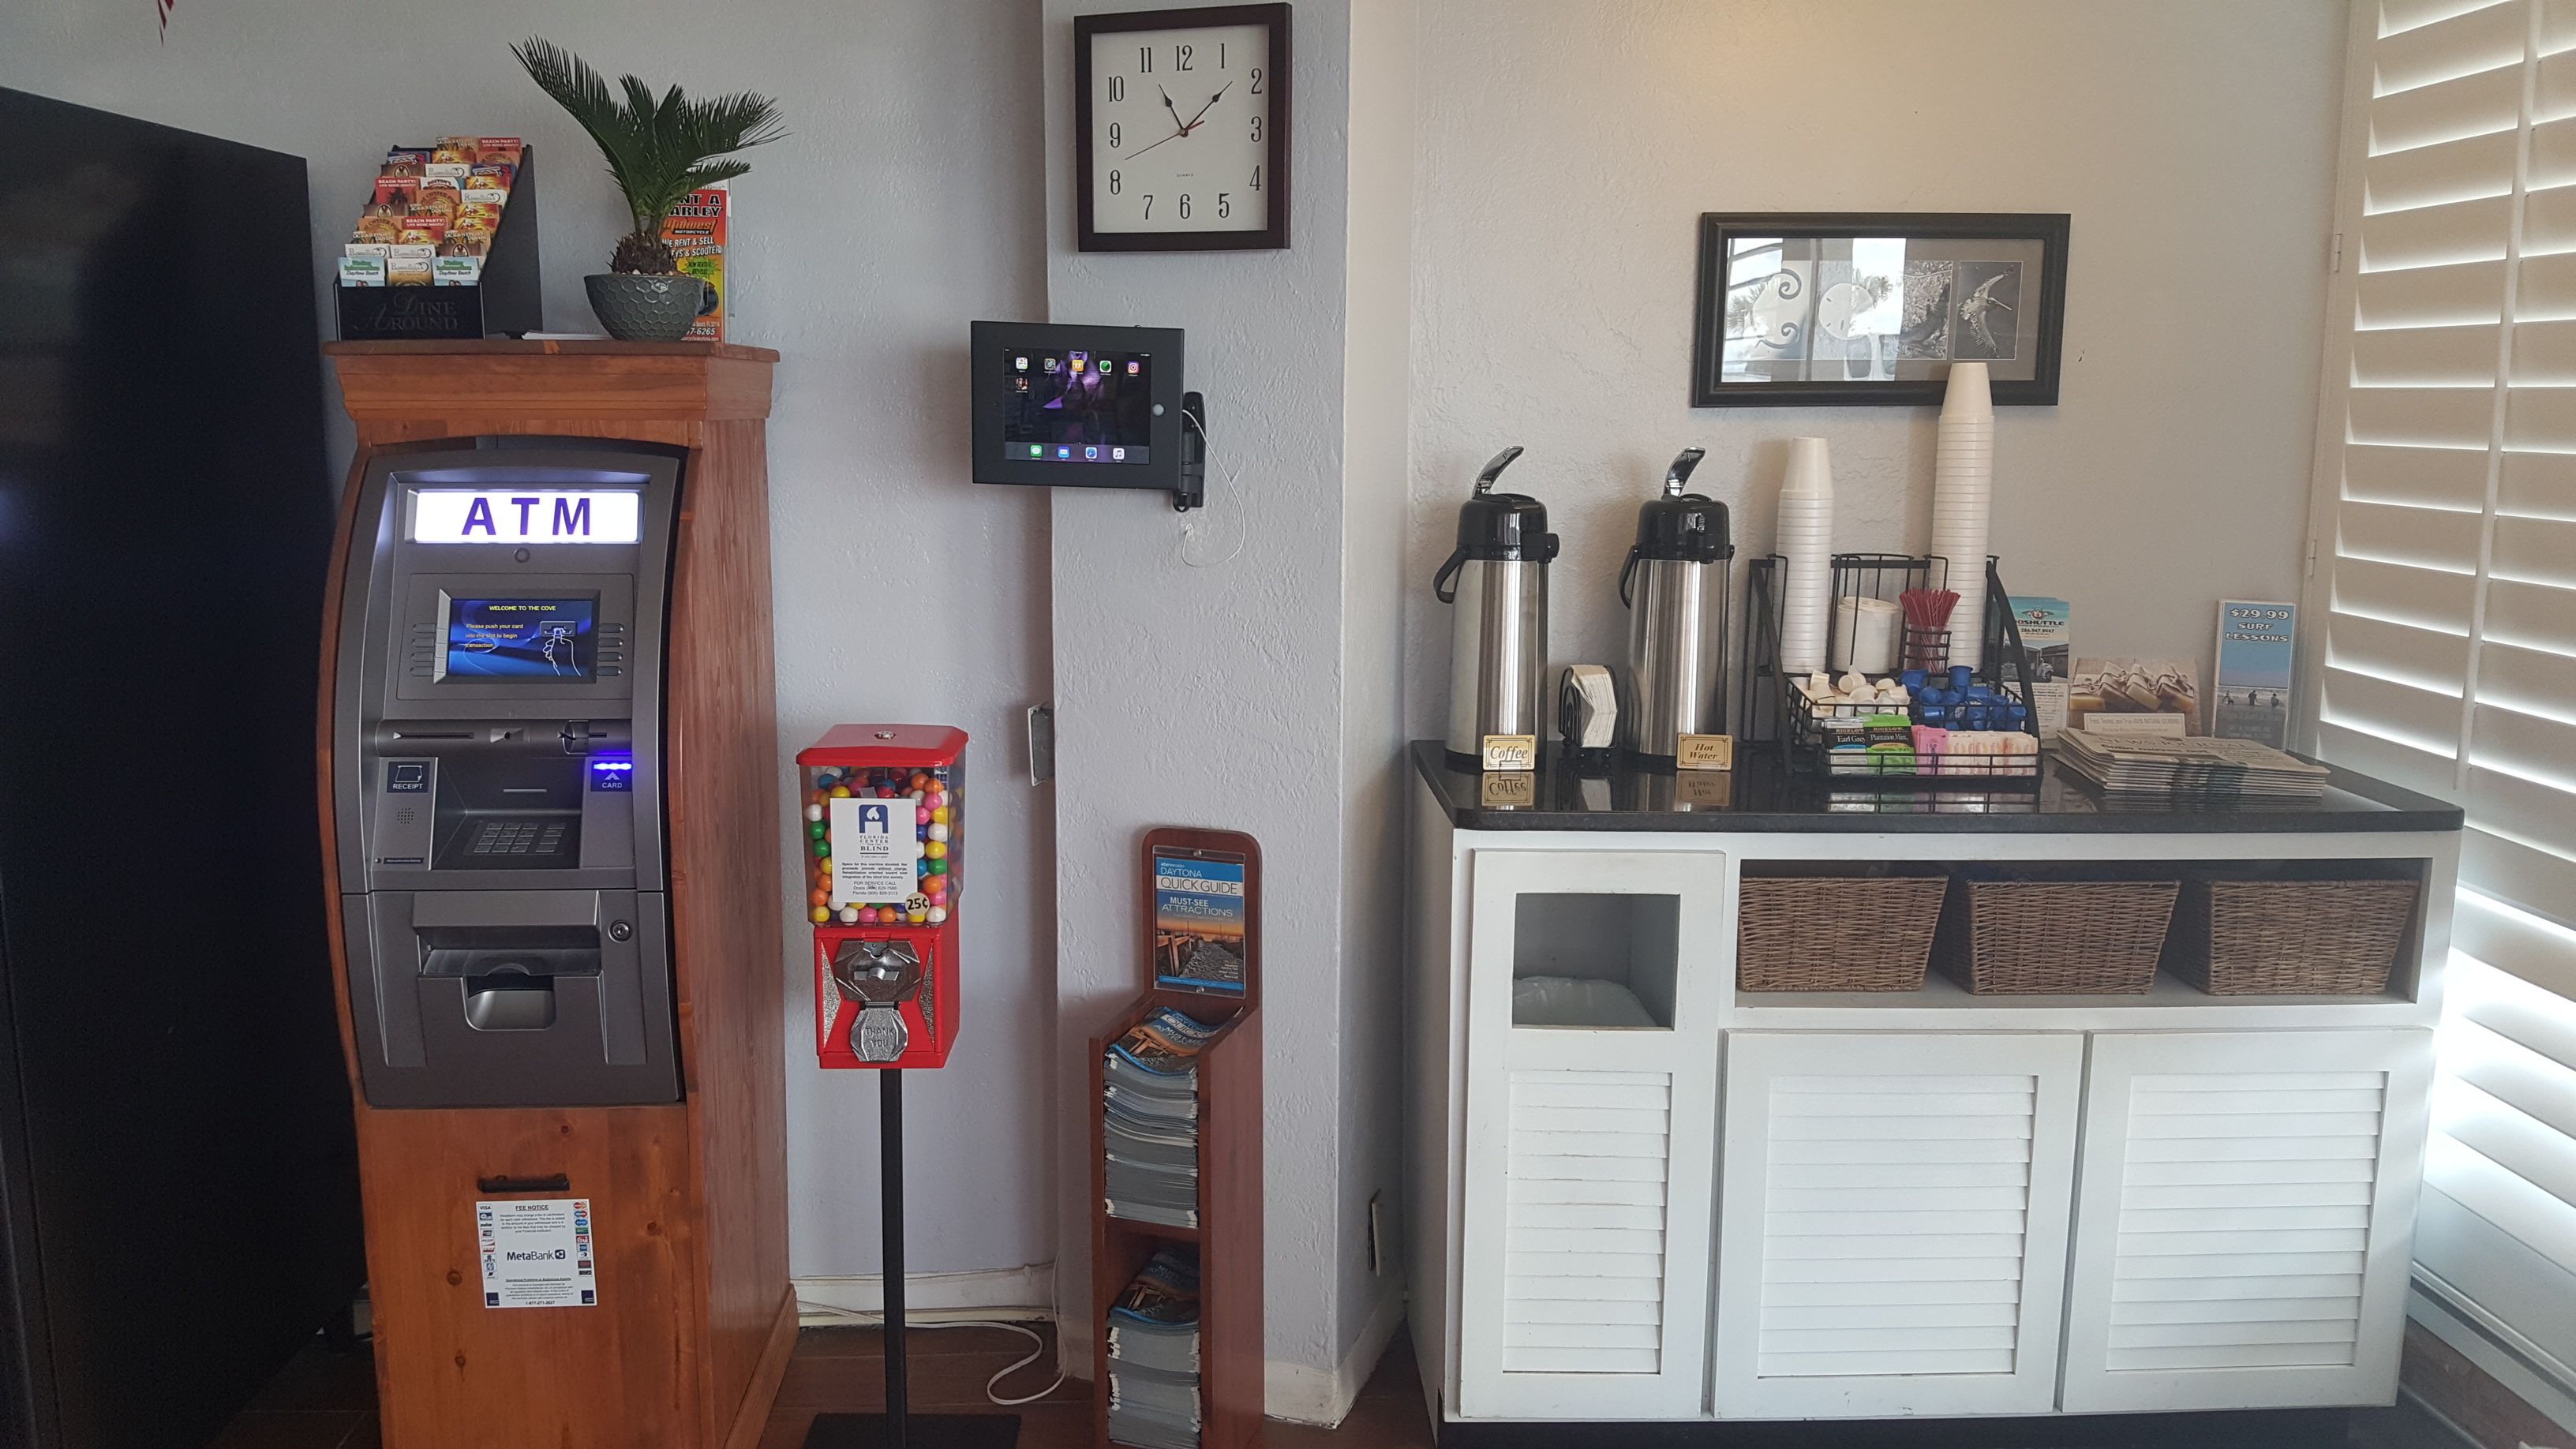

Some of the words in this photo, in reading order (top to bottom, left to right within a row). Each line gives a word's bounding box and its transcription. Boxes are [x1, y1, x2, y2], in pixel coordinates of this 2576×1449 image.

[1140, 47, 1151, 73] 11
[1176, 45, 1193, 71] 12
[1220, 43, 1225, 69] 1
[1108, 76, 1124, 102] 10
[1251, 68, 1262, 94] 2
[1110, 122, 1121, 148] 9
[1251, 116, 1261, 142] 3
[1110, 170, 1121, 195] 8
[1249, 165, 1261, 190] 4
[709, 194, 721, 205] A
[1143, 195, 1153, 220] 7
[1180, 194, 1190, 219] 6
[1219, 193, 1230, 218] 5
[668, 206, 721, 217] ARLEY
[675, 238, 691, 247] RENT
[699, 236, 714, 245] SELL
[395, 291, 456, 315] DINE
[462, 497, 590, 536] ATM
[2230, 608, 2290, 620] $29.99
[2237, 622, 2273, 631] SURF
[2226, 632, 2289, 642] LESSONS
[1490, 745, 1528, 762] Coffee
[1160, 867, 1202, 878] DAYTONA
[1161, 877, 1199, 891] QUICK
[1200, 880, 1237, 894] GUIDE
[906, 897, 929, 911] 25¢
[1162, 904, 1234, 917] ATTRACTIONS
[1170, 897, 1210, 907] MUST-SEE
[865, 1028, 894, 1036] THANK
[507, 1250, 555, 1261] MetaBank
